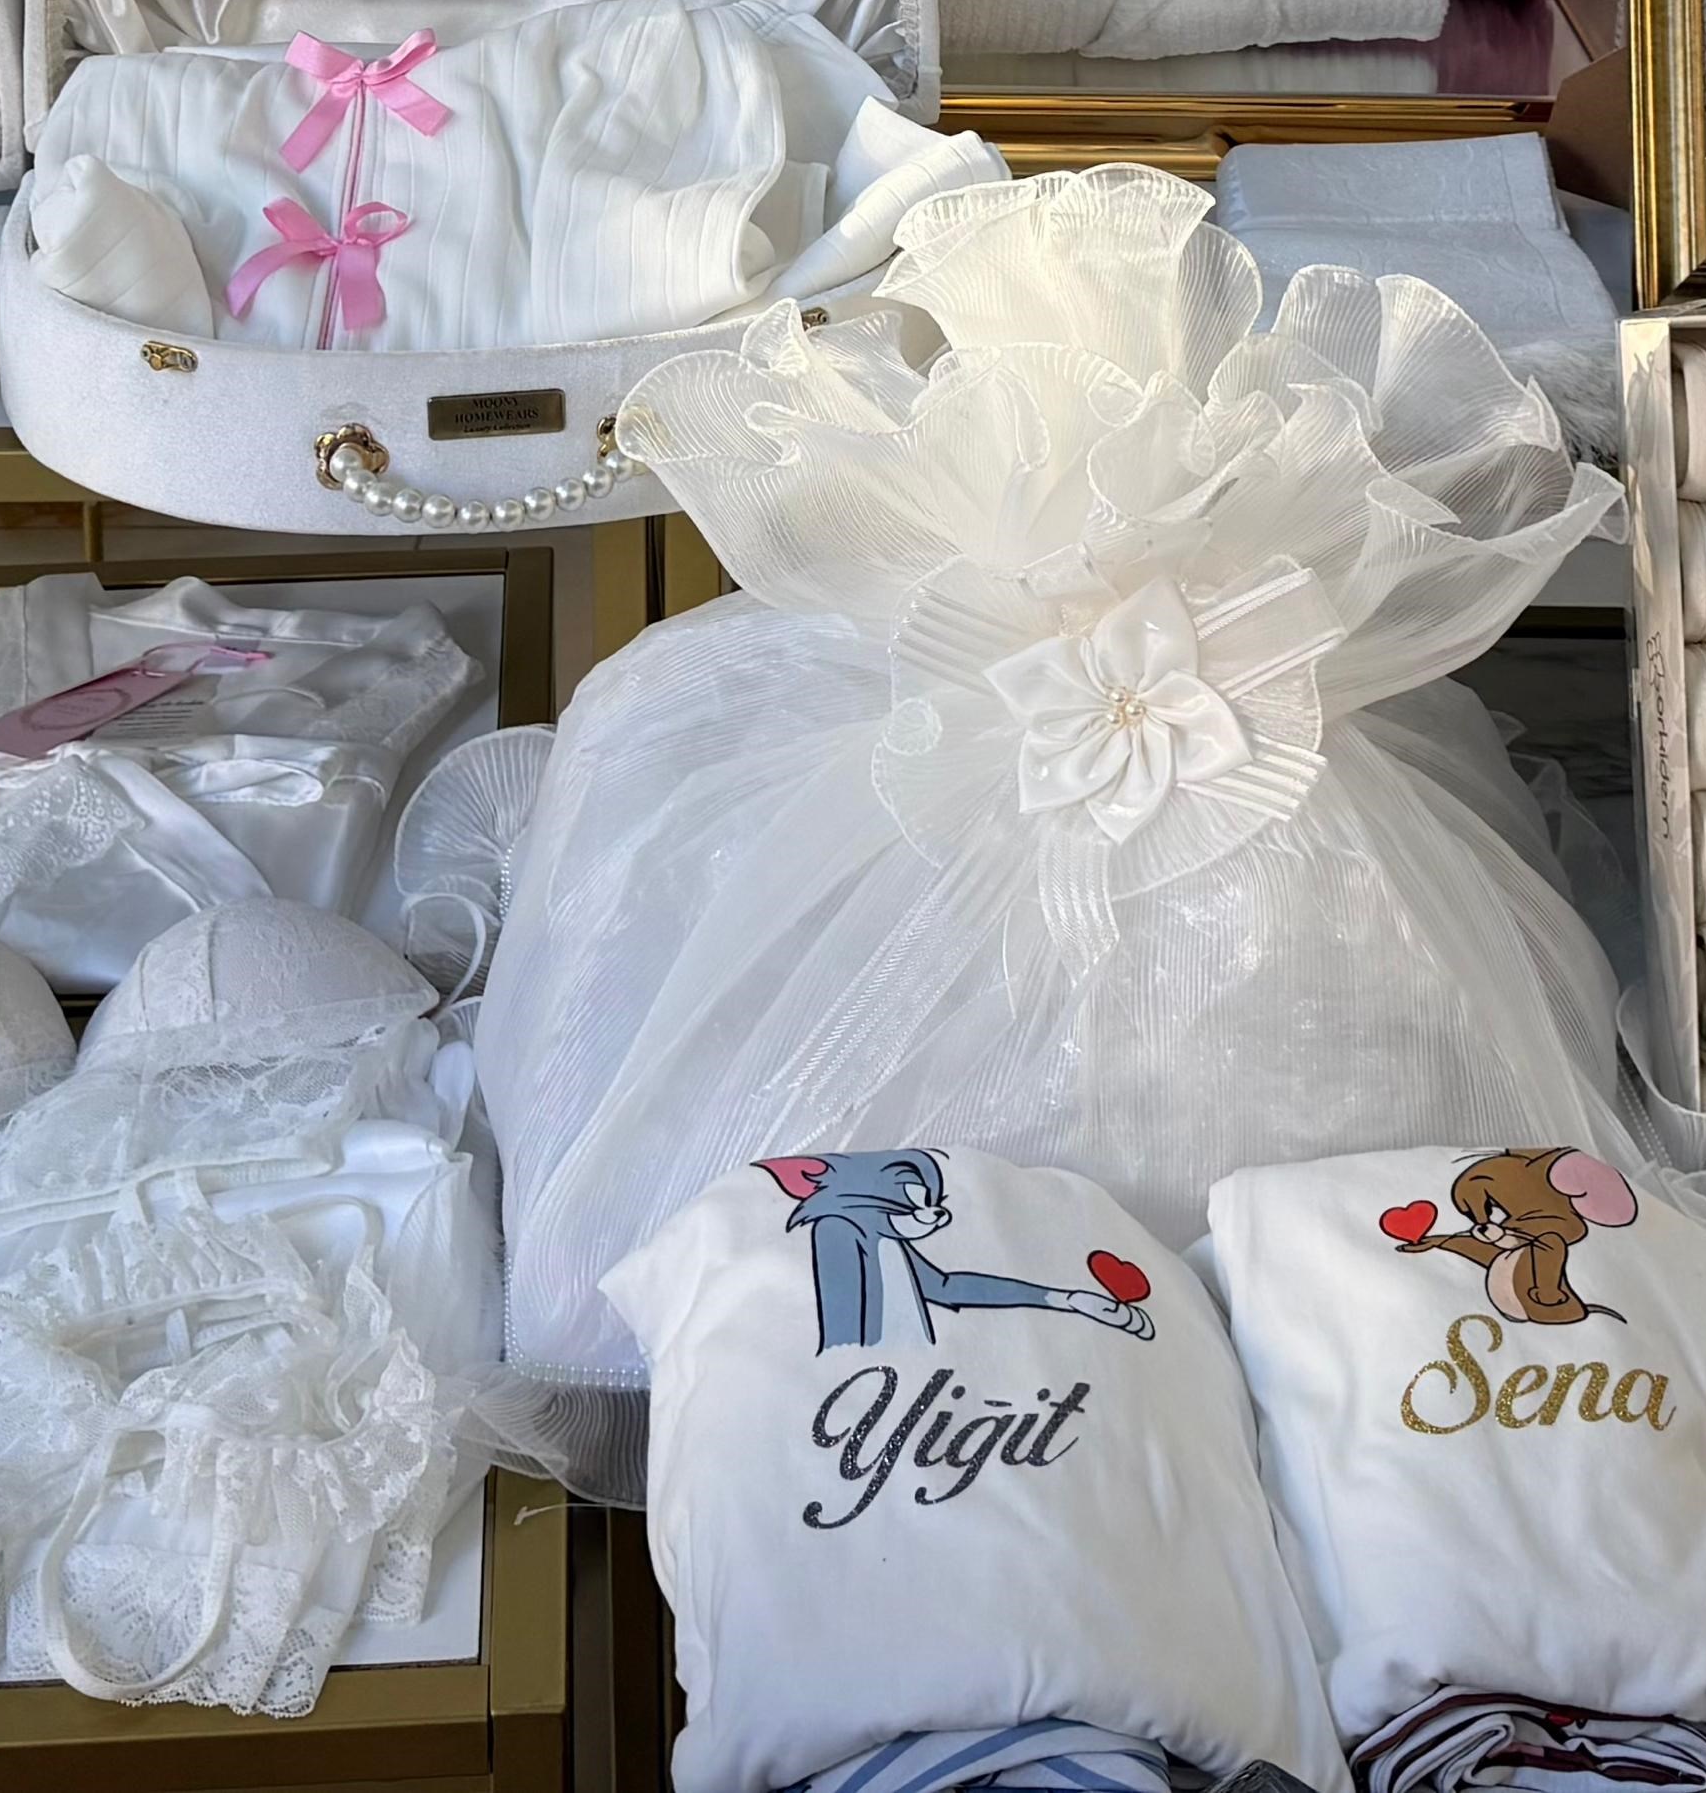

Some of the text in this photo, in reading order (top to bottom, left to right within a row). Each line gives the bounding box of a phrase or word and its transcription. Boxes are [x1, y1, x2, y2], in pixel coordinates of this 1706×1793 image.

[472, 397, 519, 409] MOONY
[455, 409, 539, 423] HOMEWEARS
[1400, 1313, 1675, 1435] Sena
